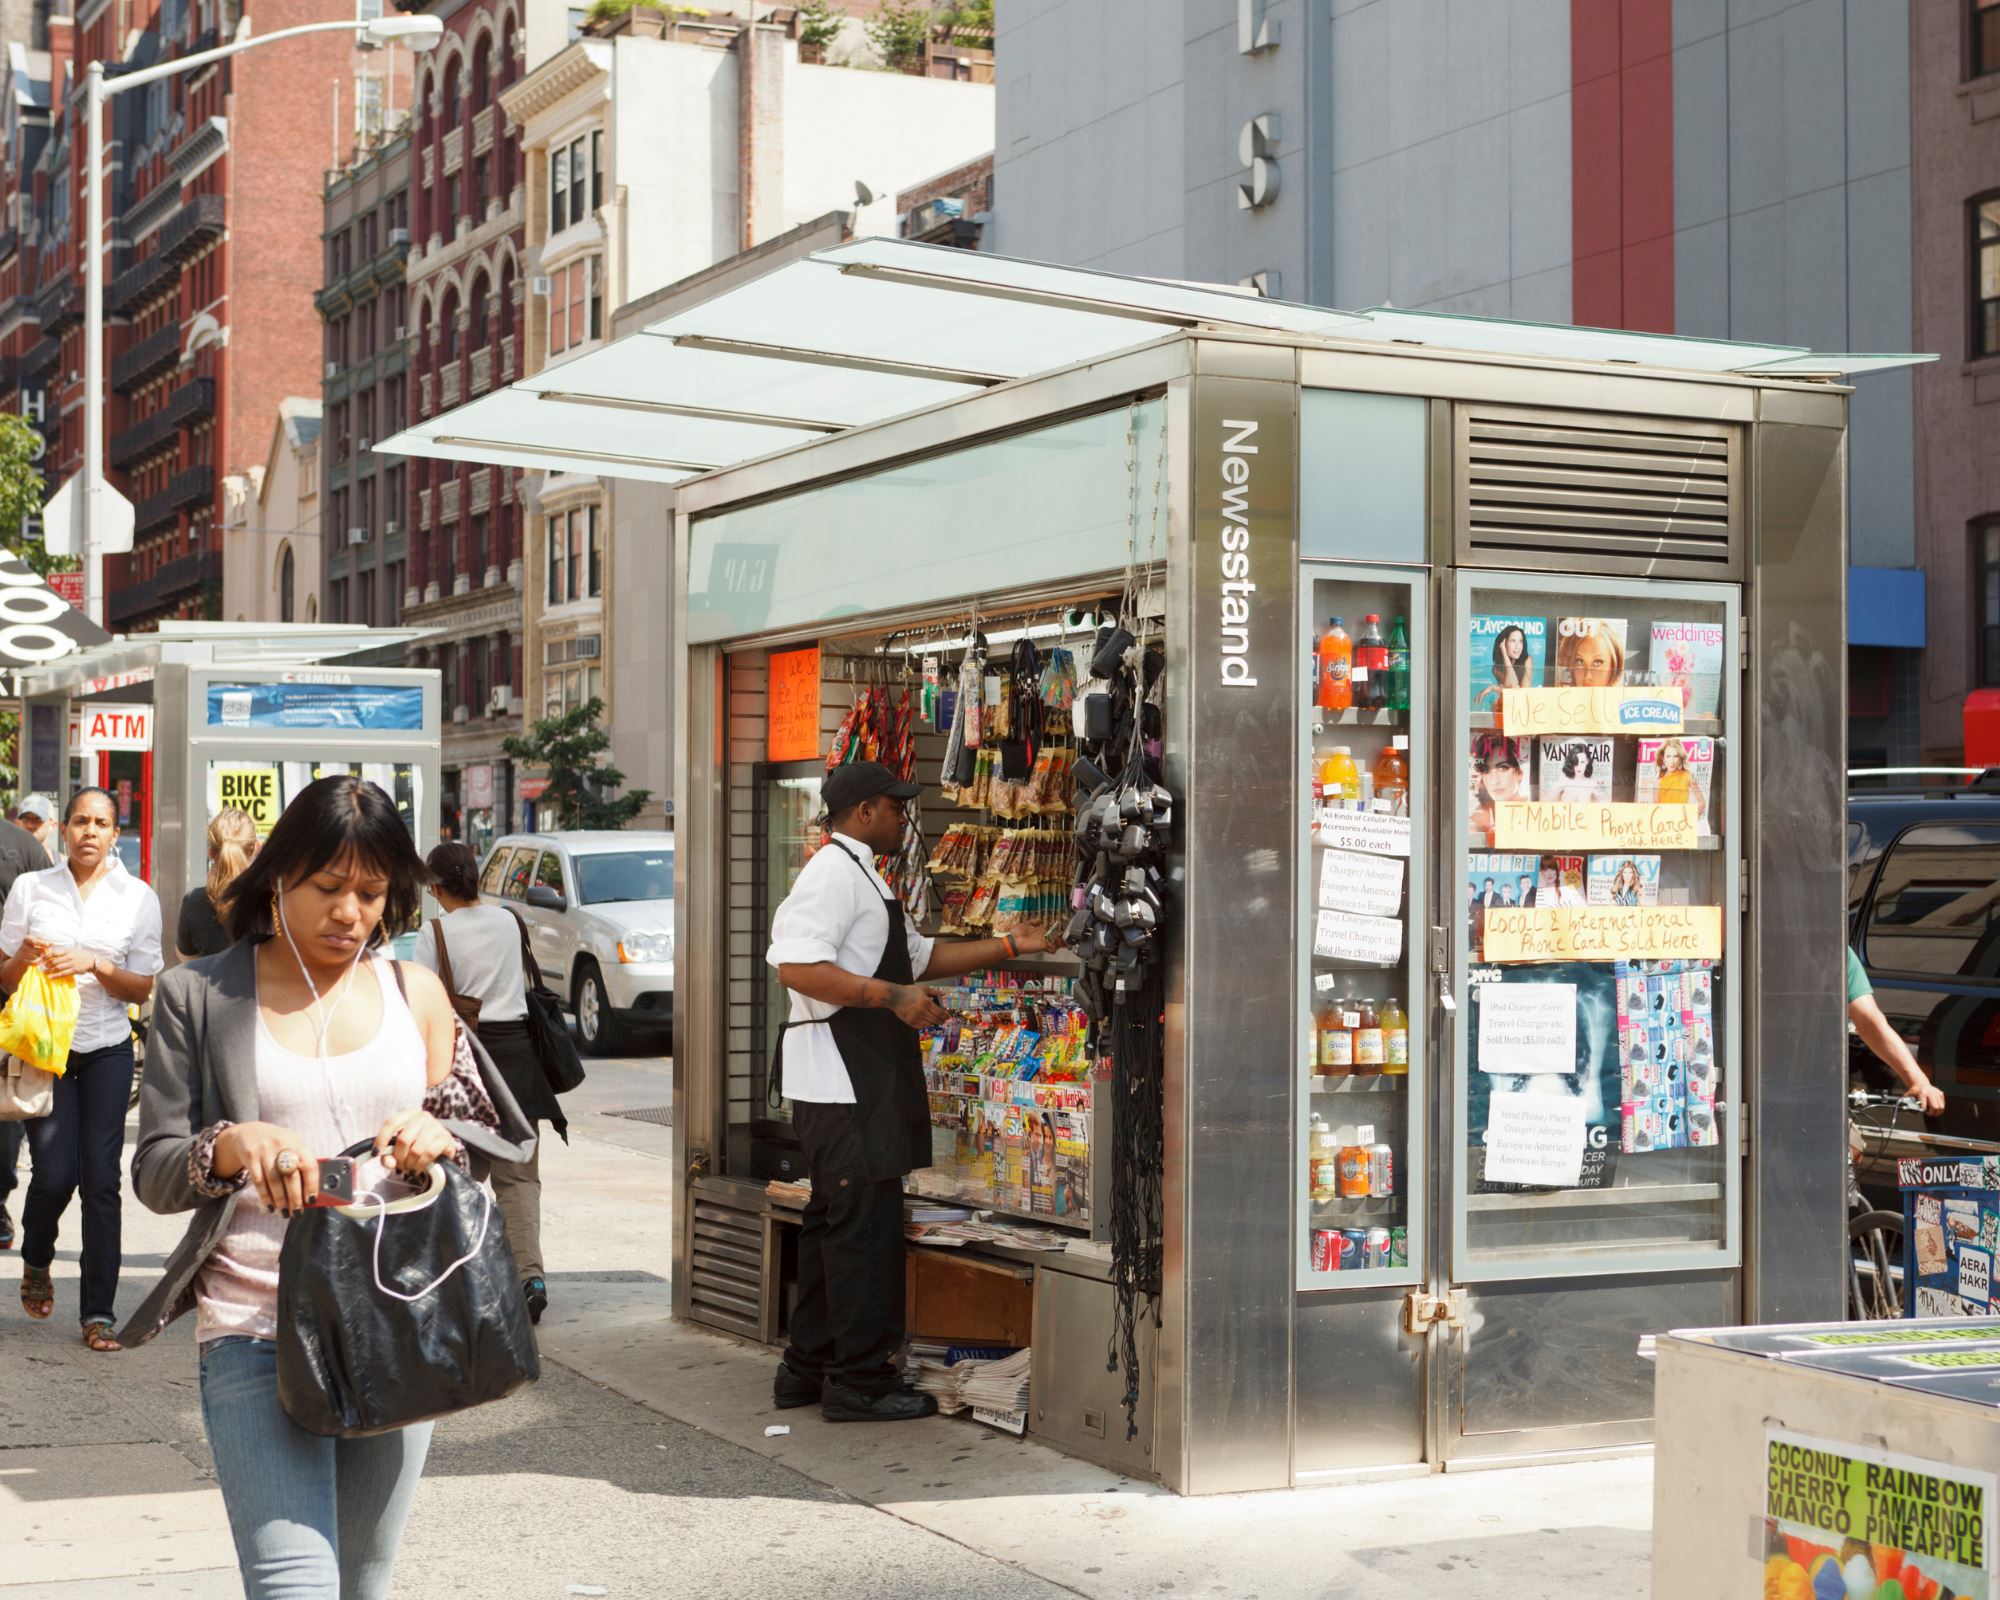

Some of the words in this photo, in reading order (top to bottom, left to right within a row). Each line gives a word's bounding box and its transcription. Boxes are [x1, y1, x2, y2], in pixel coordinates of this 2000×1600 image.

[1222, 419, 1258, 690] Newsstand
[1652, 623, 1722, 650] weddings
[297, 674, 351, 685] CEMUSA
[1511, 689, 1545, 728] We
[1557, 690, 1618, 727] Sell
[1624, 706, 1640, 719] ICE
[1641, 706, 1679, 722] CREAM
[91, 713, 145, 739] ATM
[1588, 745, 1610, 762] FAIR
[1642, 743, 1710, 763] Inyle
[222, 775, 272, 797] BIKE
[1601, 808, 1644, 838] Phone
[1650, 805, 1693, 832] Card
[1341, 837, 1367, 848] $5.00
[1369, 841, 1391, 850] each
[1589, 855, 1659, 882] Luky
[1487, 910, 1544, 932] Local
[1568, 908, 1693, 931] International
[1521, 934, 1565, 954] Phone
[1573, 931, 1606, 950] Card
[1618, 931, 1656, 953] Sold
[1580, 1165, 1604, 1176] DAY
[1923, 1165, 1960, 1185] ONLY.
[1960, 1256, 1988, 1275] AERA
[1960, 1272, 1988, 1291] HAKR
[1768, 1440, 1852, 1482] COCONUT
[1866, 1463, 1984, 1512] RAINBOW
[1767, 1466, 1850, 1502] CHERRY
[1866, 1491, 1983, 1541] TAMARINDO
[1767, 1492, 1851, 1535] MANGO
[1865, 1514, 1984, 1568] PINEAPPLE
